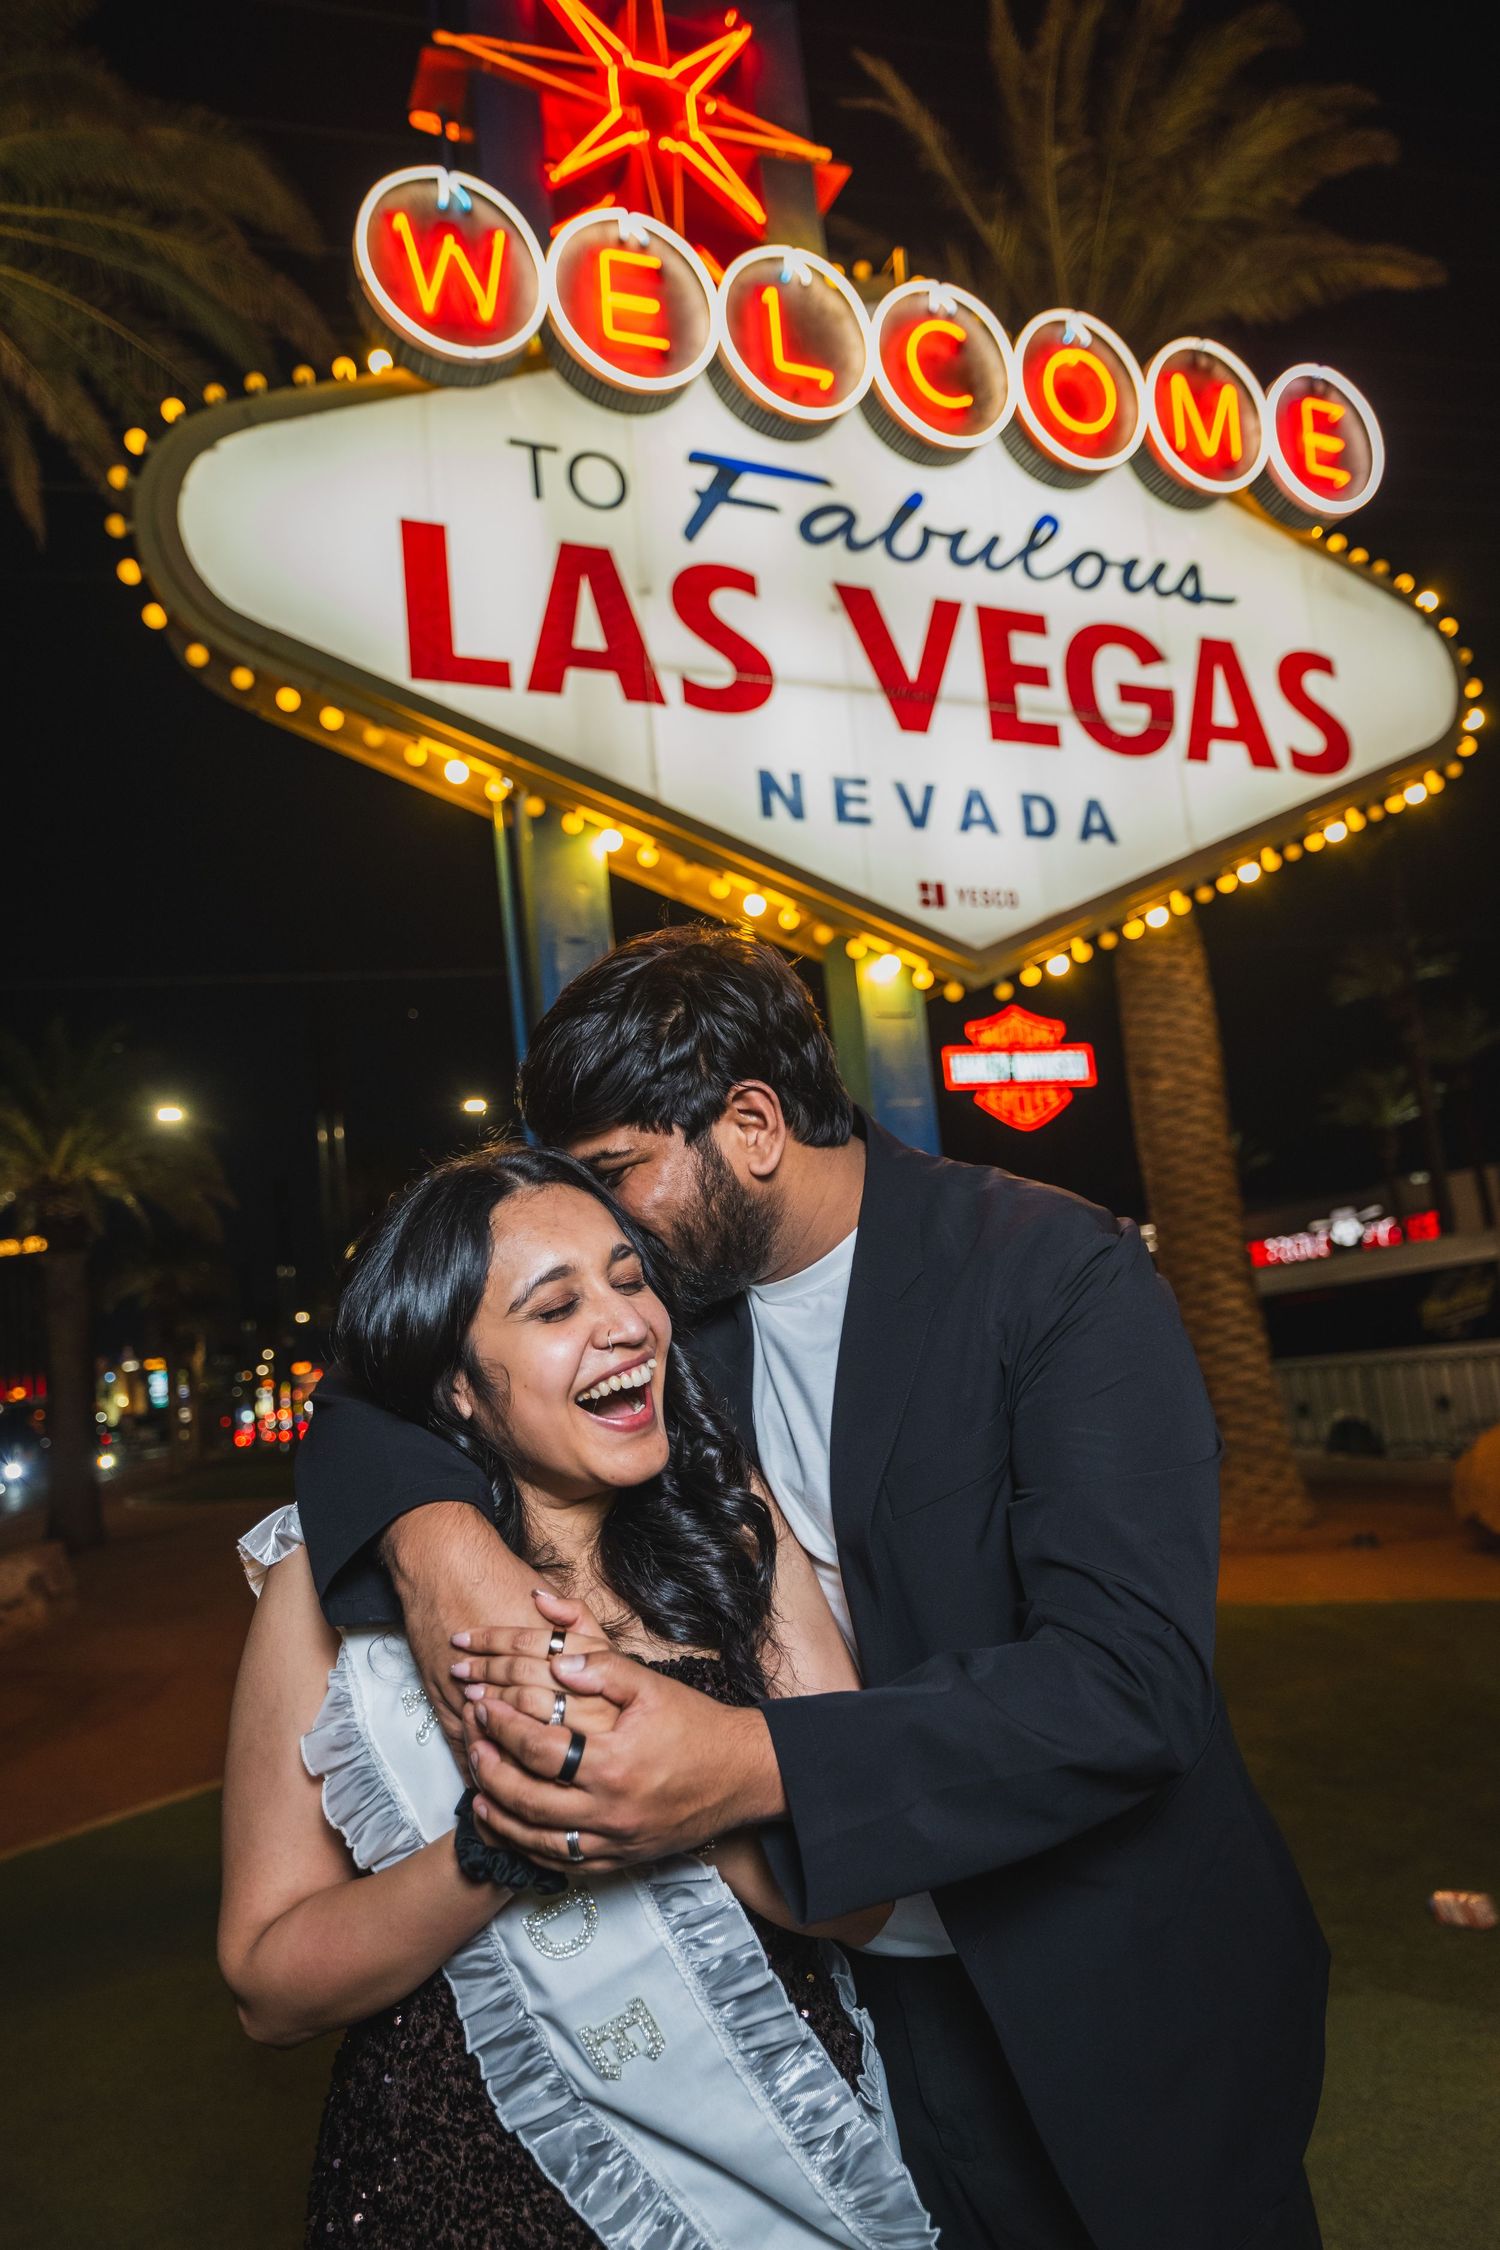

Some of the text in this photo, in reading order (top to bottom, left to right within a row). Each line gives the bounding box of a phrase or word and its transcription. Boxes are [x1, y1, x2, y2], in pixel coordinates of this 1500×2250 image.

[391, 210, 1351, 488] WELCOME
[508, 437, 1237, 605] TO Fabulous
[399, 517, 1353, 777] LAS VEGAS
[757, 769, 1119, 845] NEVADA
